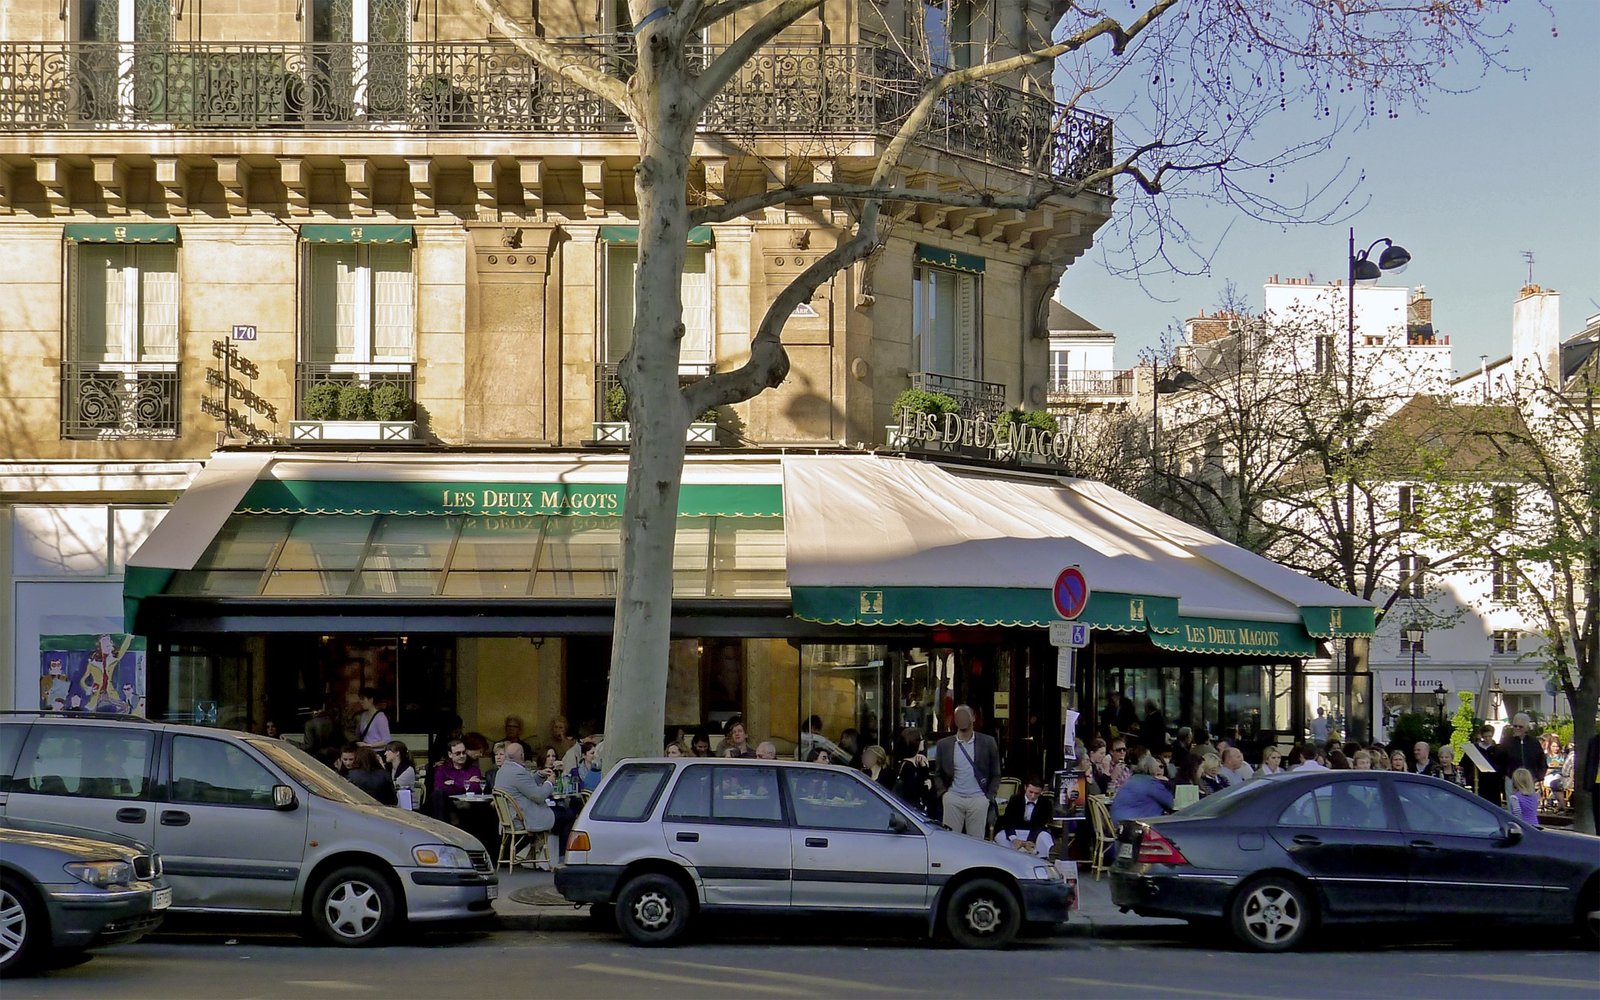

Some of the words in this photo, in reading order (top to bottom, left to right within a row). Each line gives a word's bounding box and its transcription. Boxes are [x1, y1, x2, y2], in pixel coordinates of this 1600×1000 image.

[234, 327, 255, 339] 170
[899, 405, 937, 442] LES
[942, 412, 1001, 449] DEUX
[442, 489, 475, 508] LES
[482, 489, 533, 509] DEUX
[540, 490, 618, 509] MAGOTS
[1185, 624, 1206, 643] LES
[1208, 625, 1236, 645] DEUX
[1239, 628, 1279, 647] MAGOTS
[1395, 677, 1406, 687] la
